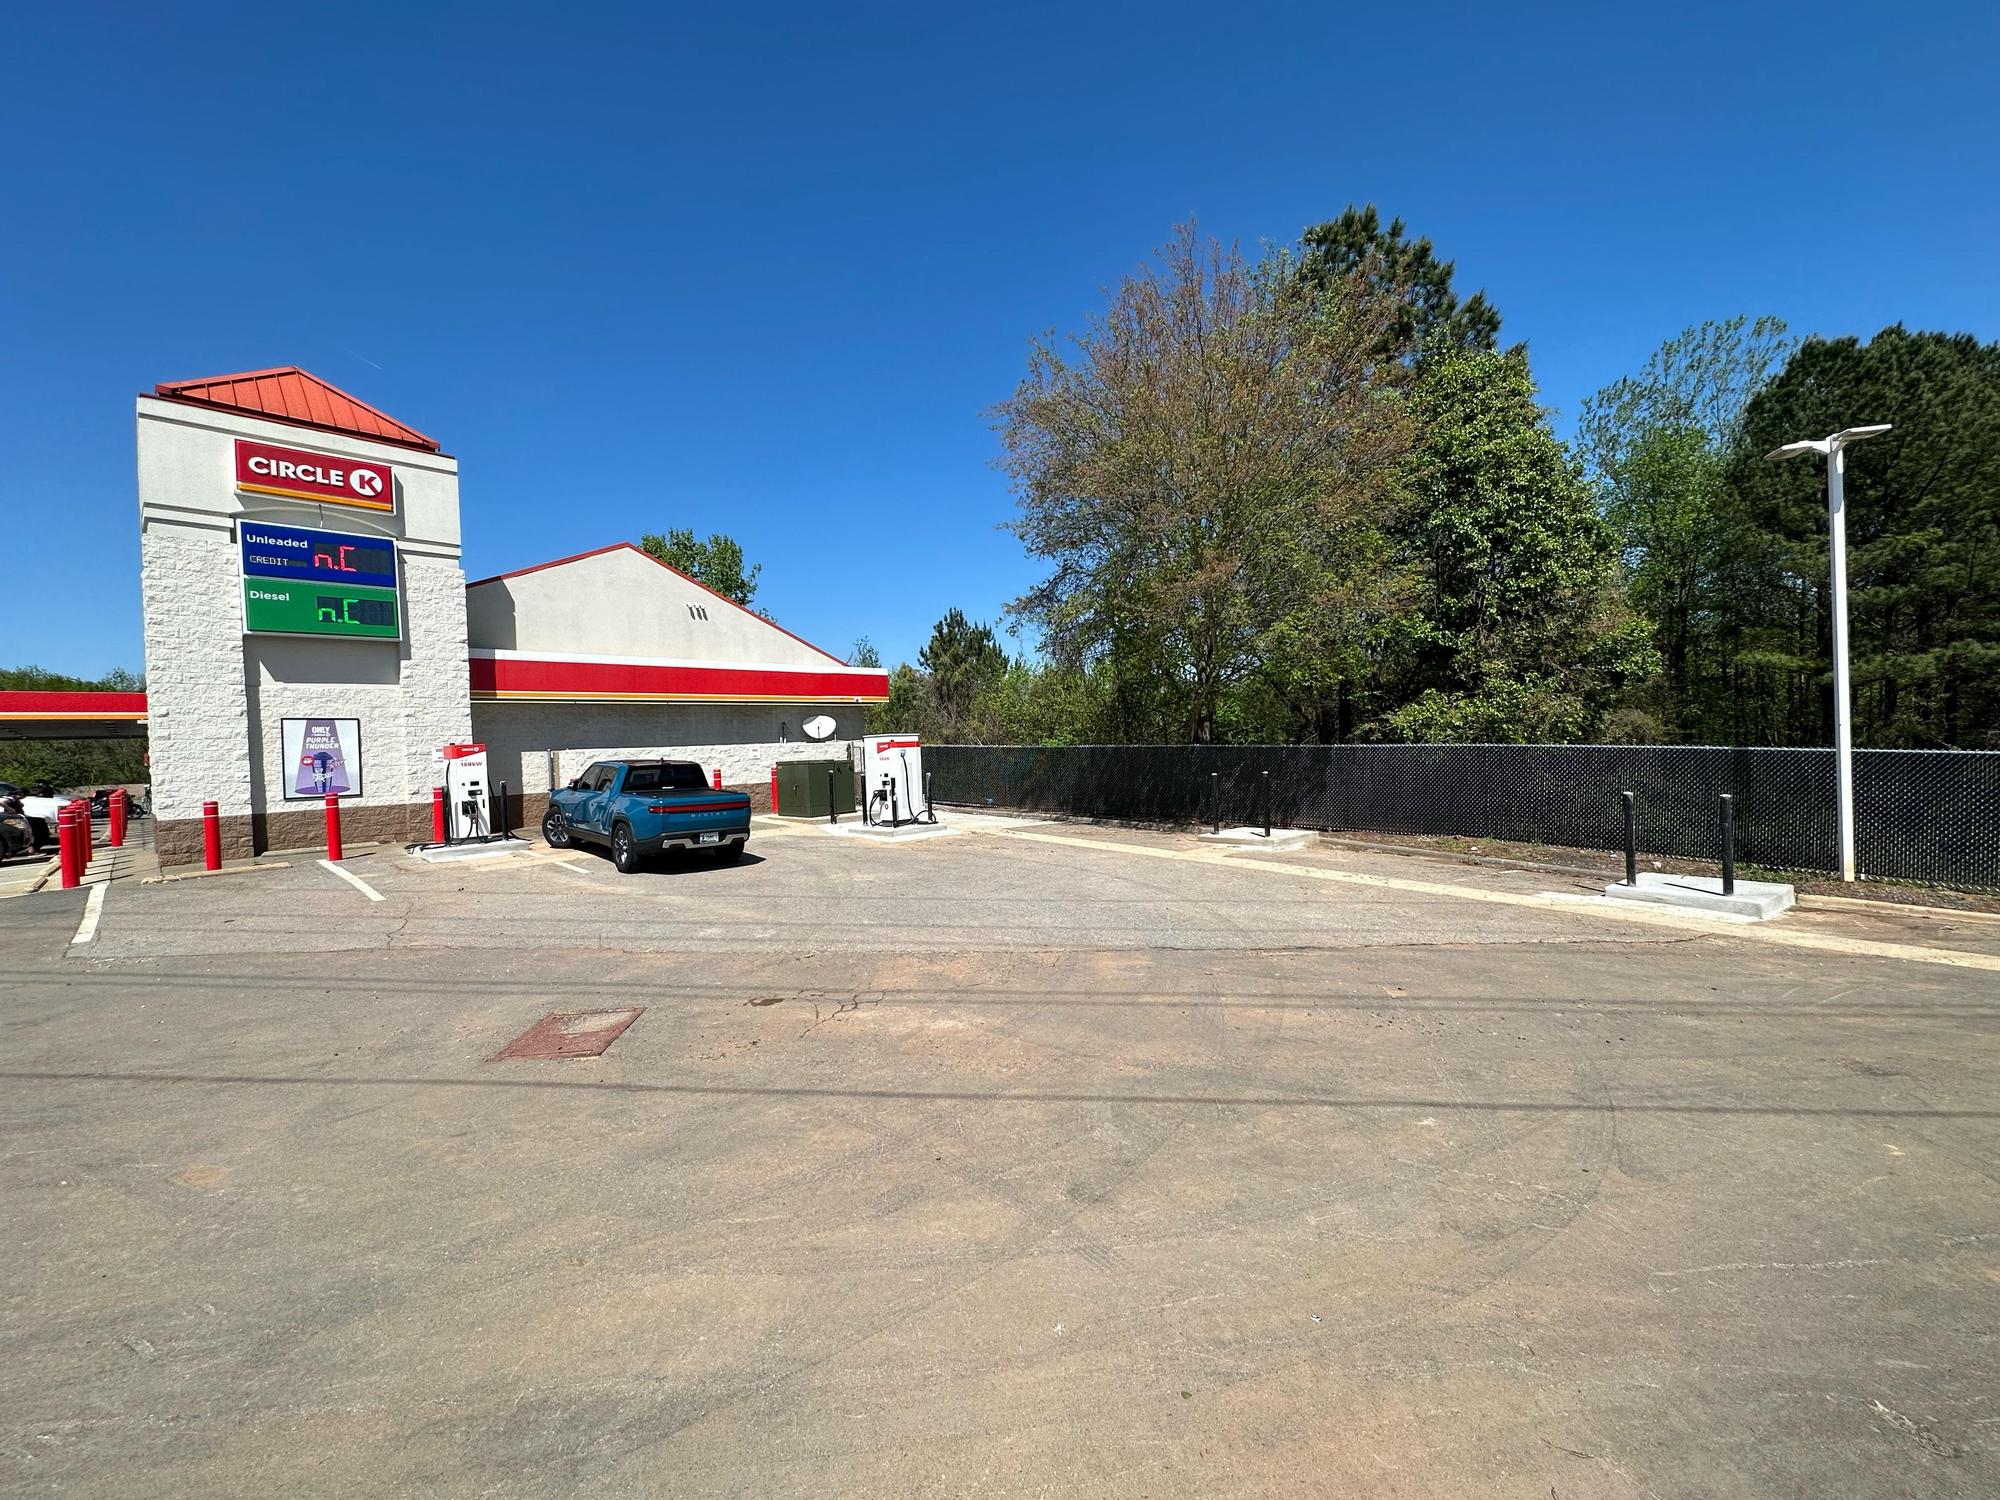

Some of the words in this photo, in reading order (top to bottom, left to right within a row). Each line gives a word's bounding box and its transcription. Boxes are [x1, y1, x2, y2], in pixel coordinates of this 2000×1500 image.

[248, 456, 345, 487] CIRCLE
[355, 471, 382, 496] K
[246, 533, 308, 549] Unleaded
[249, 555, 289, 567] CREDIT
[249, 590, 290, 602] Diesel
[311, 725, 331, 735] ONLY
